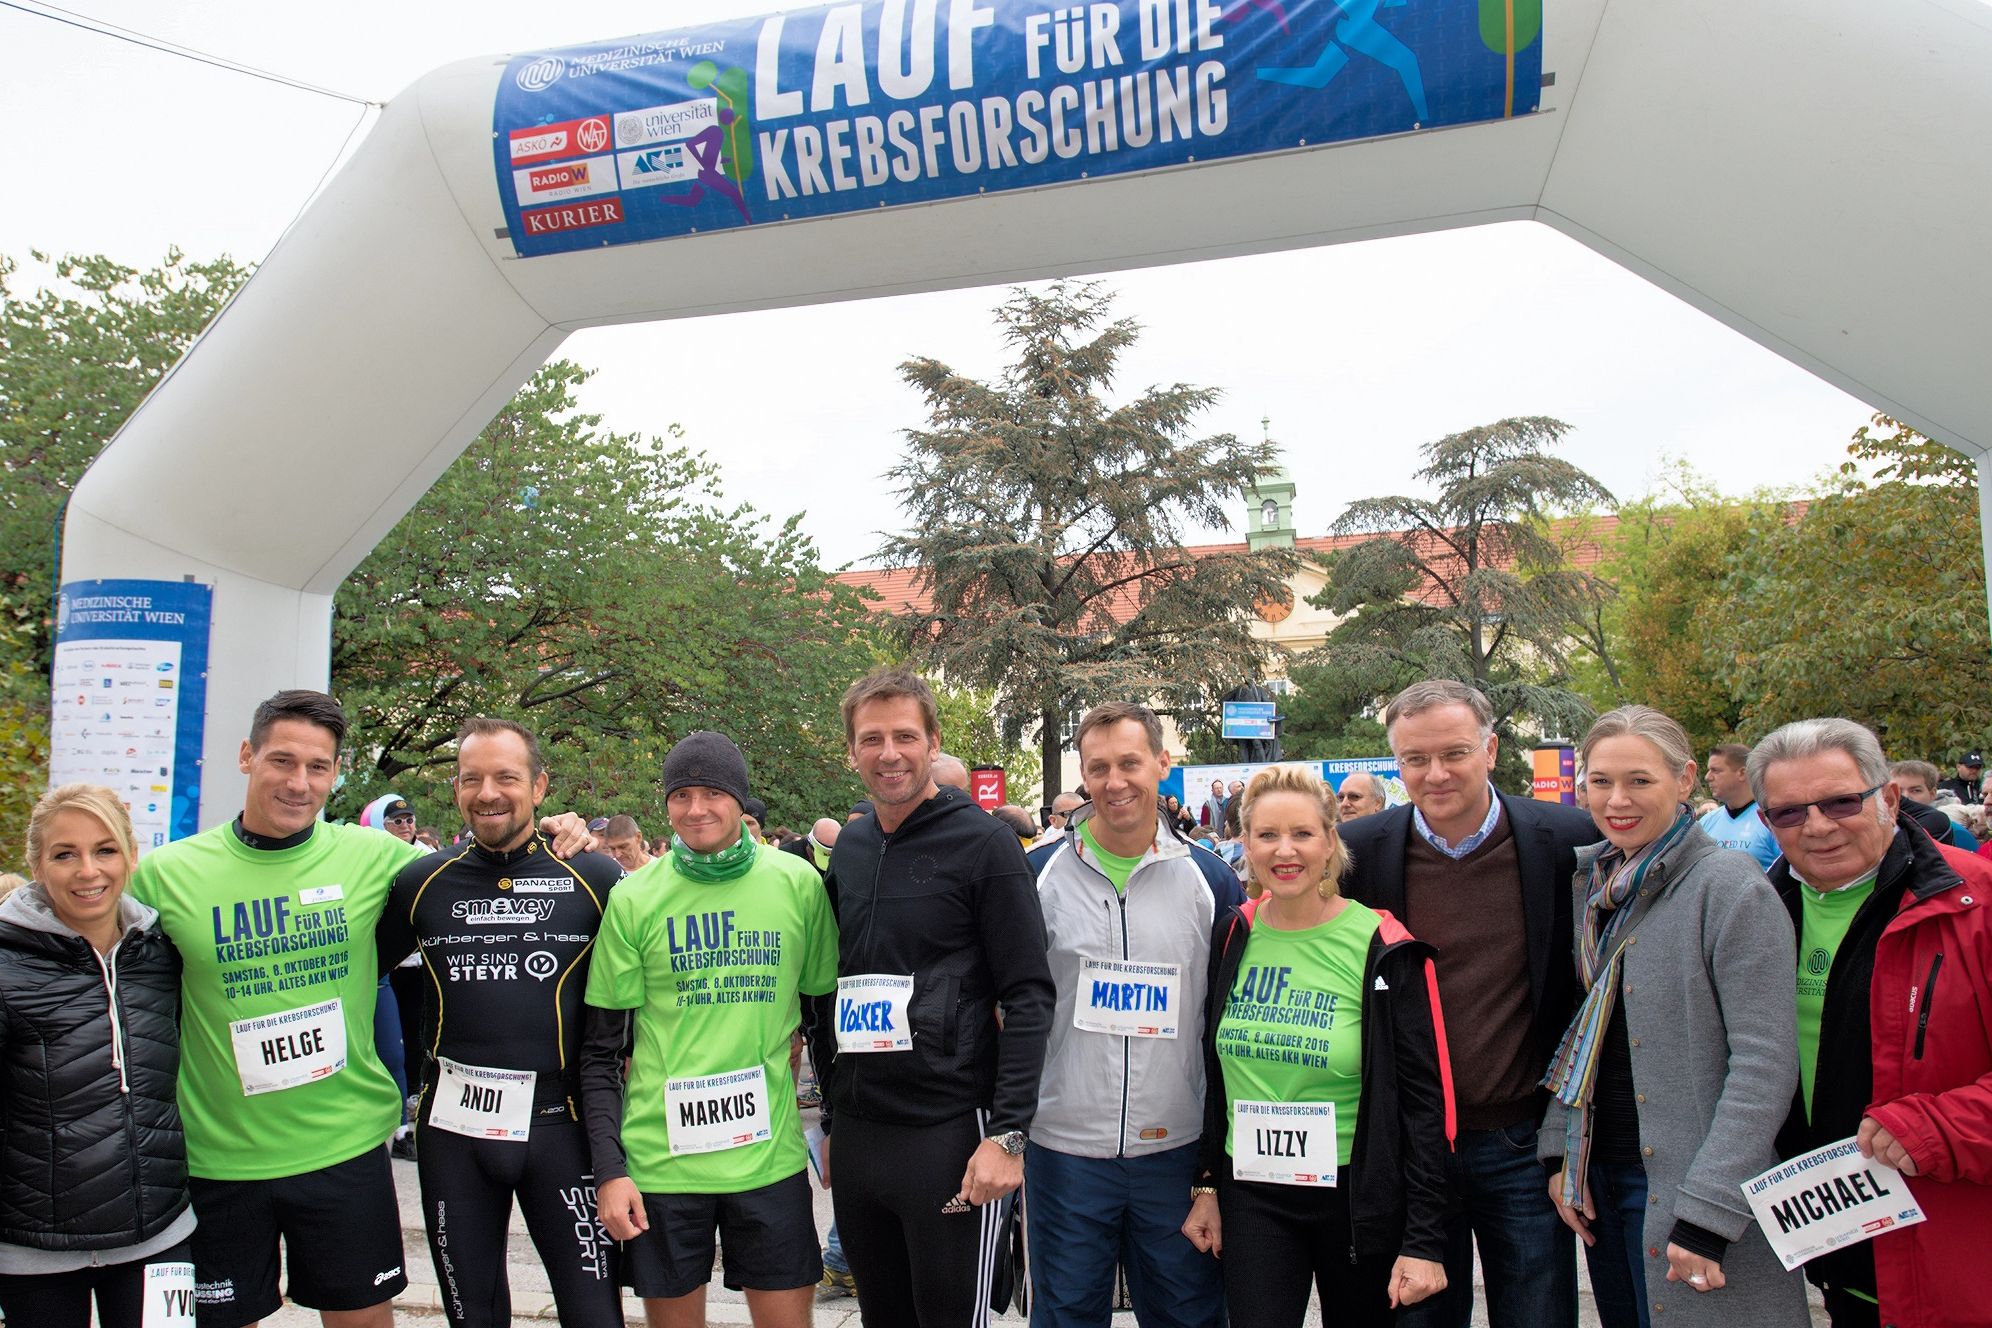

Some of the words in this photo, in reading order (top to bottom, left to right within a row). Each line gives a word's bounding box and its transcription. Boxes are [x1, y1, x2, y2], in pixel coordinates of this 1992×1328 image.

[568, 50, 676, 78] UNIVERSITÄT
[680, 41, 725, 58] WIEN
[571, 37, 690, 66] MEDIZINISCHE
[755, 0, 994, 121] LAUF
[1139, 0, 1224, 62] DIE
[646, 104, 713, 127] universität
[759, 60, 1228, 200] KREBSFORSCHUNG
[532, 172, 569, 186] RADIO
[549, 188, 571, 196] RADIO
[574, 185, 592, 194] WIEN
[529, 204, 618, 232] KURIER
[70, 596, 152, 610] MEDIZINISCHE
[70, 609, 141, 624] UNIVERSITÄT
[144, 612, 184, 624] WIEN
[212, 896, 290, 944] LAUF
[324, 907, 346, 926] DIE
[216, 925, 348, 963] KREBSFORSCHUNG!
[422, 934, 518, 947] kühberger
[523, 932, 540, 941] &
[544, 932, 589, 942] haas
[667, 910, 734, 954] LAUF
[764, 931, 780, 948] DIE
[273, 964, 282, 976] 8.
[284, 956, 326, 975] OKTOBER
[329, 951, 348, 966] 2016
[447, 954, 475, 966] WIR
[481, 953, 518, 964] SIND
[670, 949, 780, 973] KREBSFORSCHUNG!
[1114, 963, 1123, 972] DIE
[225, 985, 252, 999] 10-14
[280, 975, 306, 991] ALTES
[308, 970, 327, 985] AKH
[328, 965, 348, 980] WIEN
[450, 966, 518, 981] STEYR
[724, 976, 760, 988] OKTOBER
[1230, 966, 1292, 1005] LAUF
[716, 992, 740, 1003] ALTES
[742, 991, 758, 1002] AKH
[1090, 980, 1168, 1012] MARTIN
[1314, 992, 1338, 1012] DIE
[236, 1024, 251, 1034] LAUF
[267, 1018, 278, 1028] DIE
[279, 1002, 338, 1024] KREBSFORSCHUNG!
[840, 999, 895, 1033] VOLKER
[1225, 1002, 1334, 1030] KREBSFORSCHUNG!
[261, 1028, 324, 1065] HELGE
[1264, 1032, 1302, 1048] OKTOBER
[1305, 1037, 1329, 1052] 2016
[1256, 1047, 1280, 1061] ALTES
[1282, 1049, 1298, 1064] AKH
[1302, 1053, 1328, 1068] WIEN
[669, 1083, 682, 1091] LAUF
[696, 1080, 706, 1088] DIE
[708, 1070, 761, 1087] KREBSFORSCHUNG!
[460, 1084, 503, 1114] ANDI
[680, 1092, 756, 1127] MARKUS
[1261, 1106, 1270, 1114] DIE
[1257, 1129, 1308, 1157] LIZZY
[1749, 1181, 1768, 1195] LAUF
[1782, 1164, 1800, 1178] DIE
[1797, 1141, 1861, 1172] KREBSFORSCHU
[942, 1205, 971, 1214] adidas
[1771, 1169, 1890, 1234] MICHAEL
[438, 1200, 446, 1233] haas
[438, 1235, 447, 1247] &
[560, 1187, 600, 1279] SPORT
[441, 1249, 464, 1319] kühberger
[163, 1290, 194, 1317] YVO
